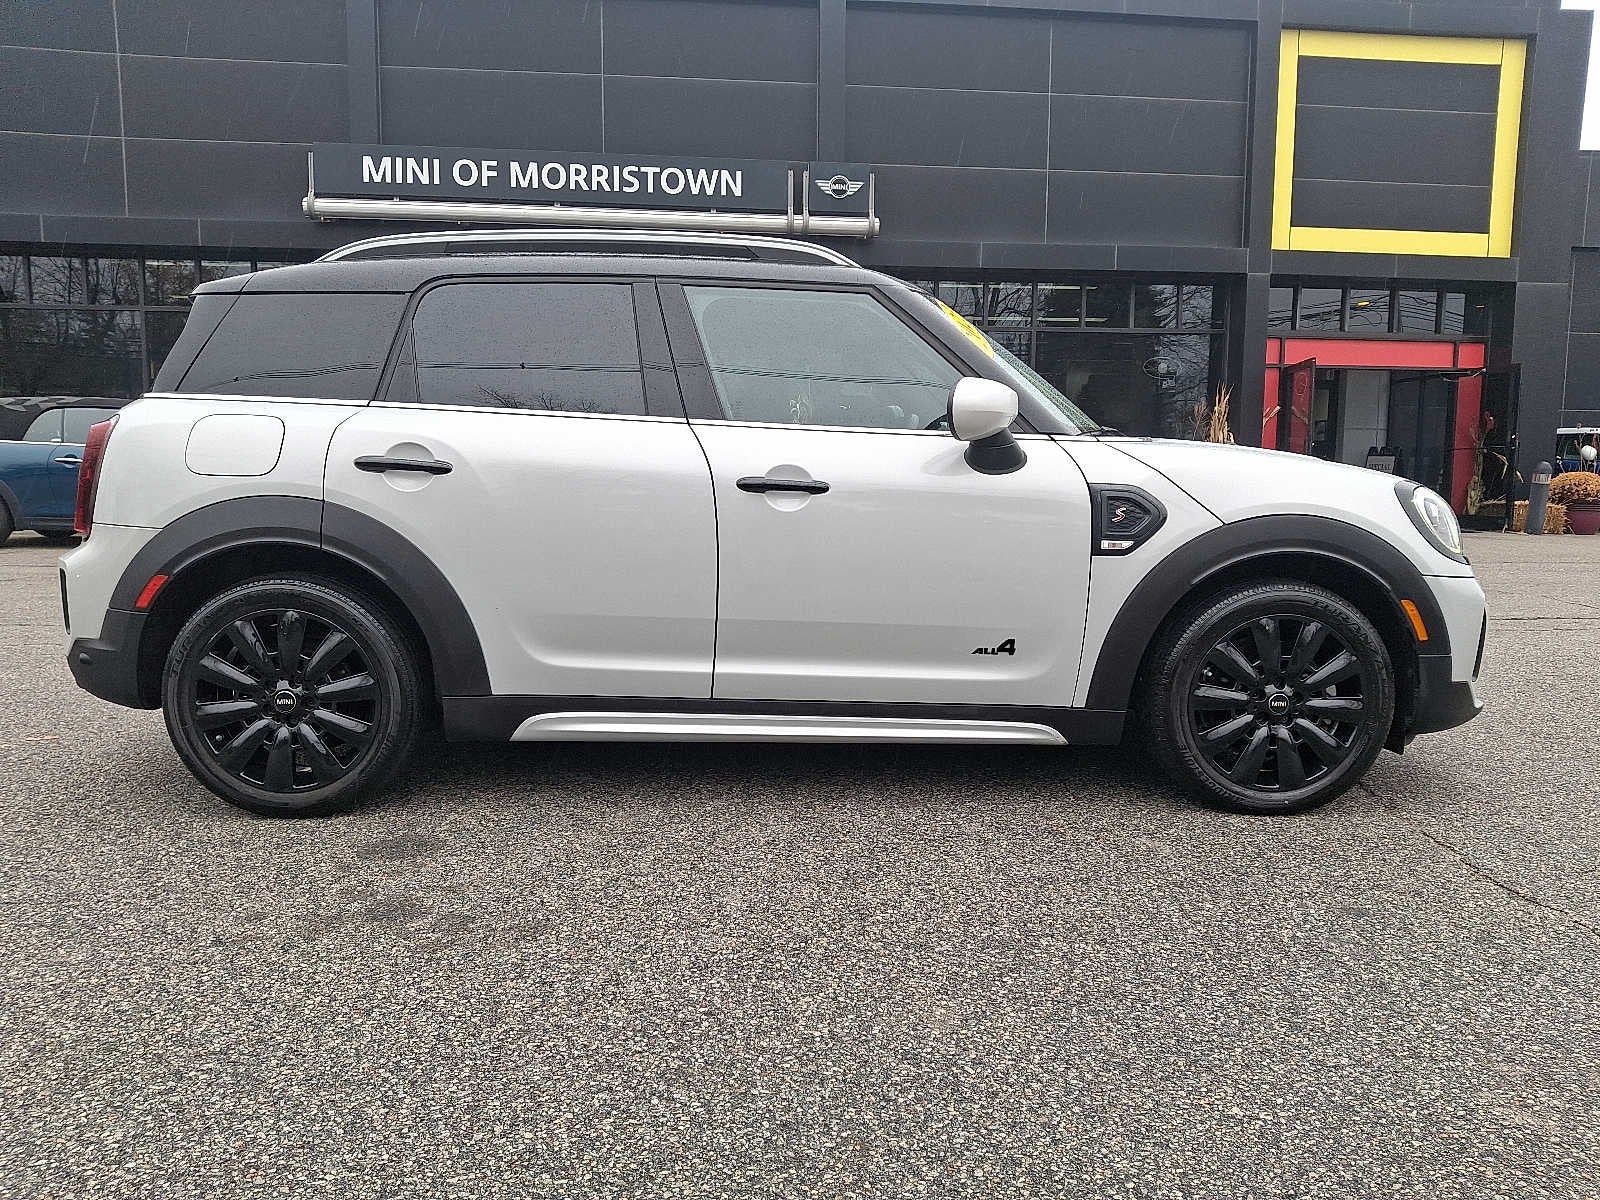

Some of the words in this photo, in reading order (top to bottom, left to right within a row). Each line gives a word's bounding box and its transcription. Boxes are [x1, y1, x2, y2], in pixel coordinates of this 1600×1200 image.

[362, 155, 440, 185] MINI
[452, 158, 498, 187] OF
[509, 161, 742, 197] MORRISTOWN
[831, 183, 848, 191] MINI
[1111, 506, 1128, 524] S
